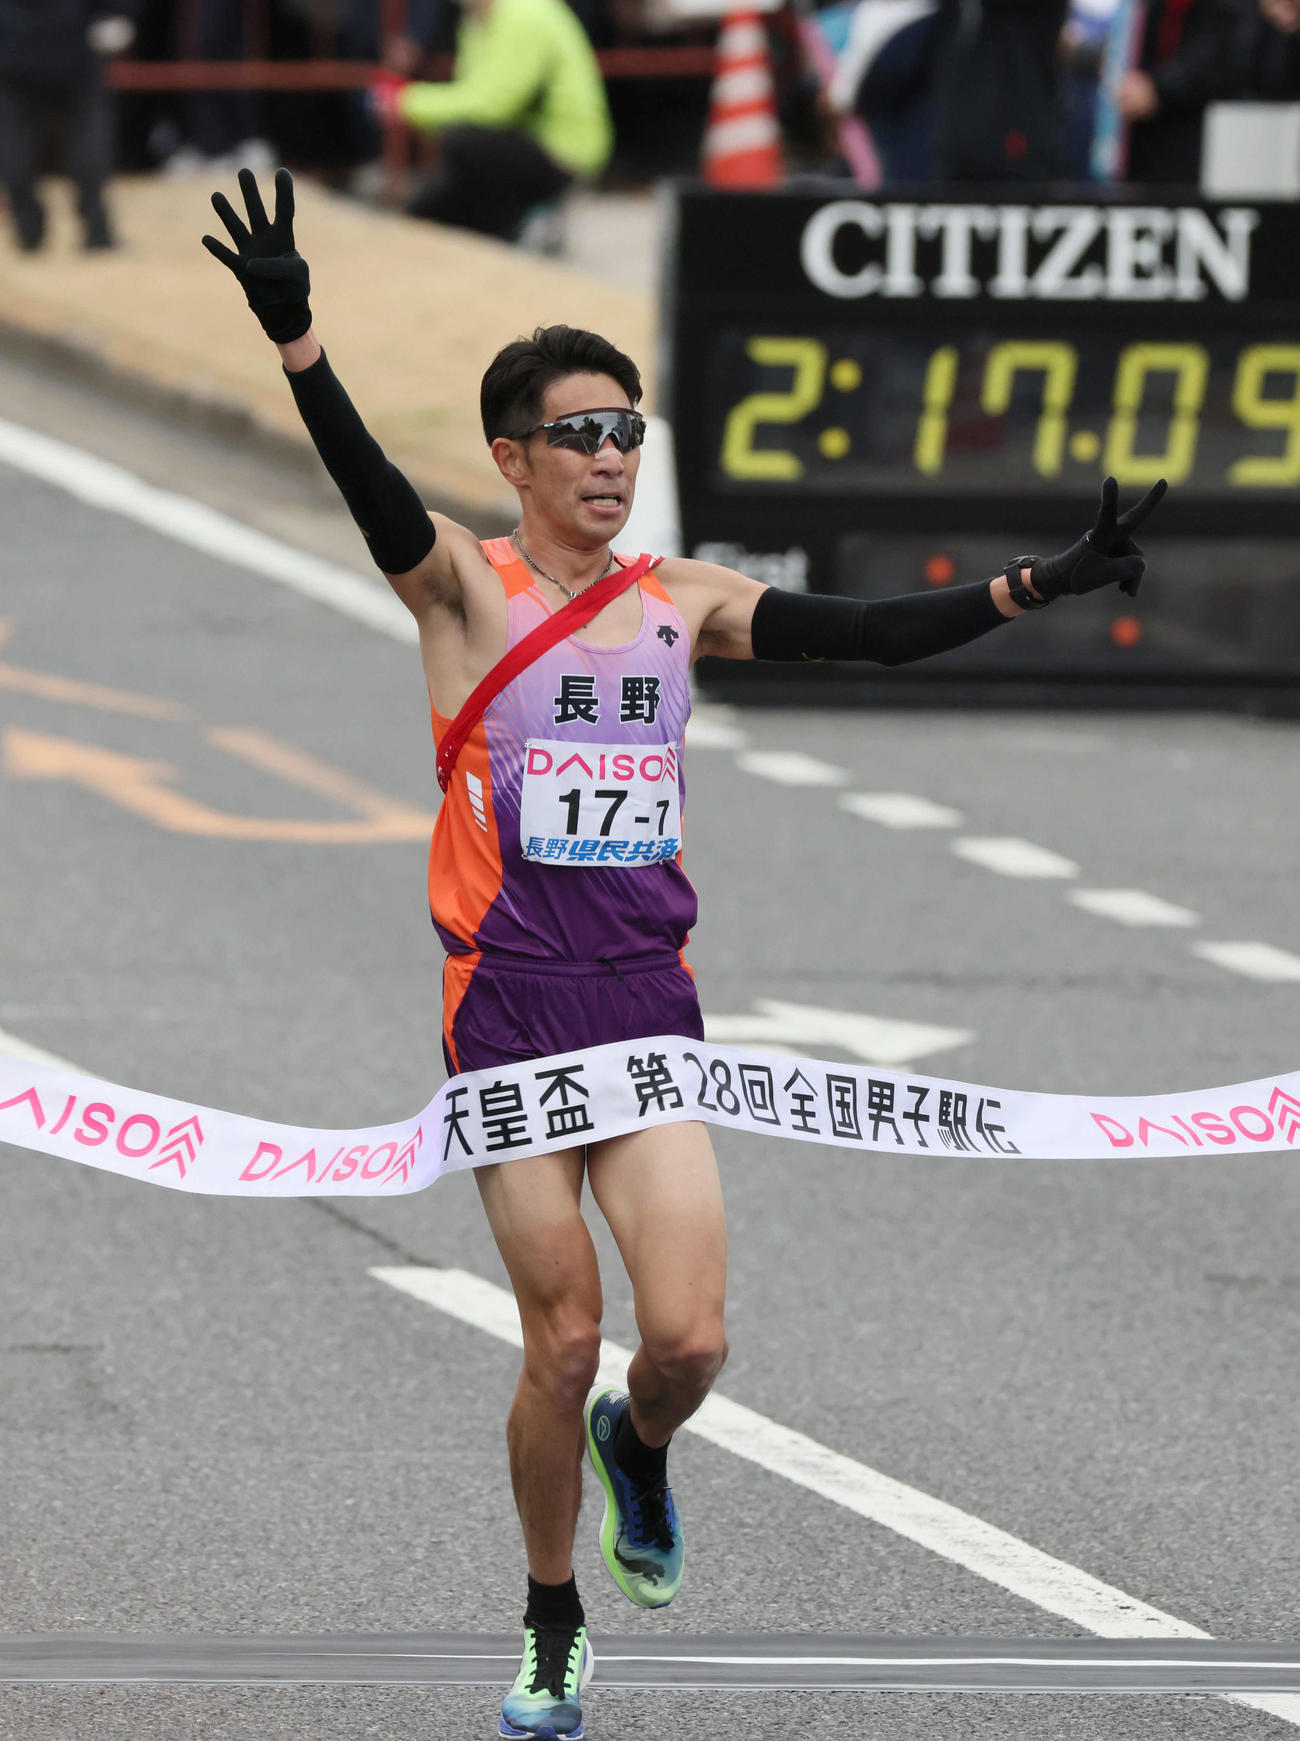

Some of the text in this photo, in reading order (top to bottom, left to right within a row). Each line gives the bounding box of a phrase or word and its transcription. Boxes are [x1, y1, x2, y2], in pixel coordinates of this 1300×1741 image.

[801, 202, 1259, 301] CITIZEN
[553, 674, 662, 726] 長野
[527, 748, 664, 782] DAISO
[525, 836, 679, 862] 長野県民共済
[1090, 1105, 1275, 1148] DAISO
[238, 1141, 398, 1184] DAISO
